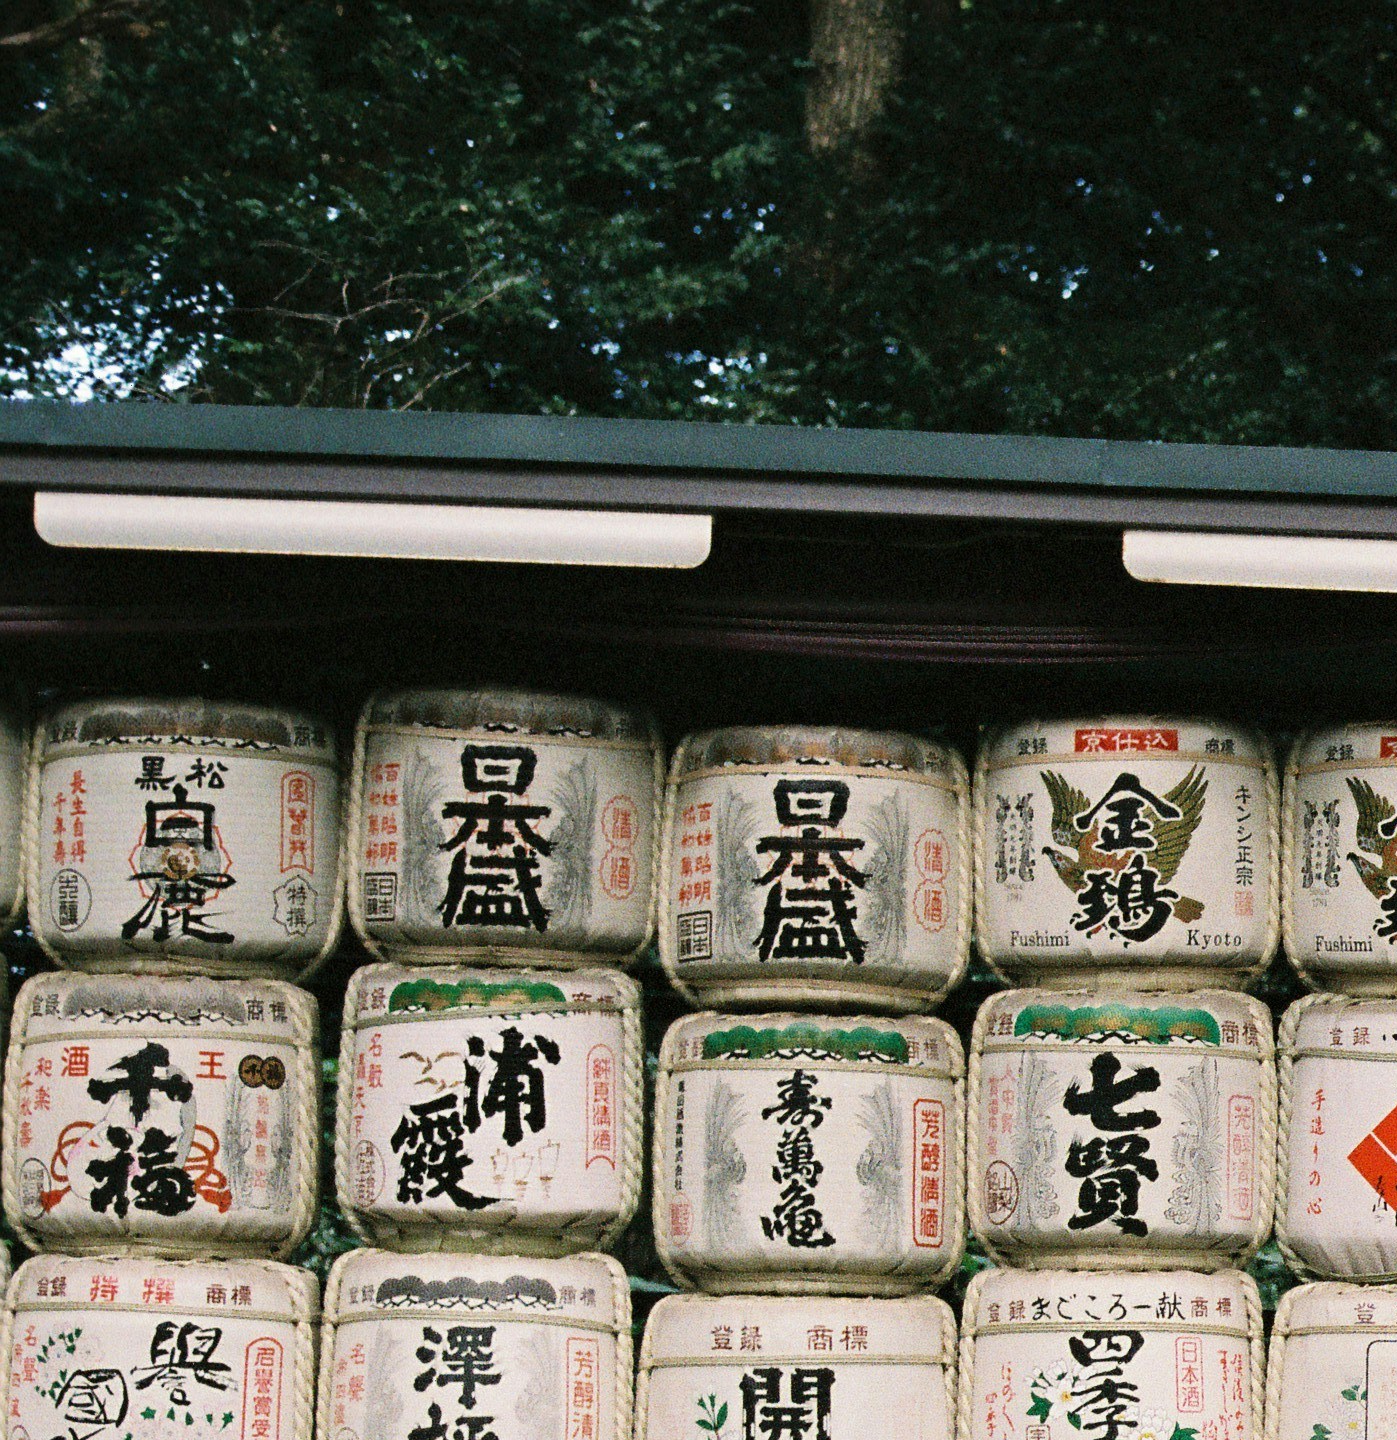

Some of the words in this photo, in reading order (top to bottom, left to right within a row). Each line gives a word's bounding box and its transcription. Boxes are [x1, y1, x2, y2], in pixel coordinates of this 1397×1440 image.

[1080, 732, 1177, 751] 京仕込
[135, 758, 228, 789] 黒松
[438, 744, 558, 932] 日本盛
[1234, 786, 1254, 886] キンシ正宗
[754, 779, 872, 964] 日本盛
[1010, 930, 1070, 948] Fushimi
[1187, 930, 1242, 948] Kyoto
[1314, 937, 1373, 955] Fushimi
[87, 1042, 196, 1220] 千福
[392, 1027, 561, 1209] 浦霞
[1064, 1052, 1162, 1239] 七賢
[1307, 1091, 1326, 1215] 手造りの心
[1032, 1293, 1184, 1321] まごころ一献
[711, 1326, 763, 1351] 登録
[808, 1326, 867, 1351] 商標
[1181, 1340, 1199, 1410] 日本酒
